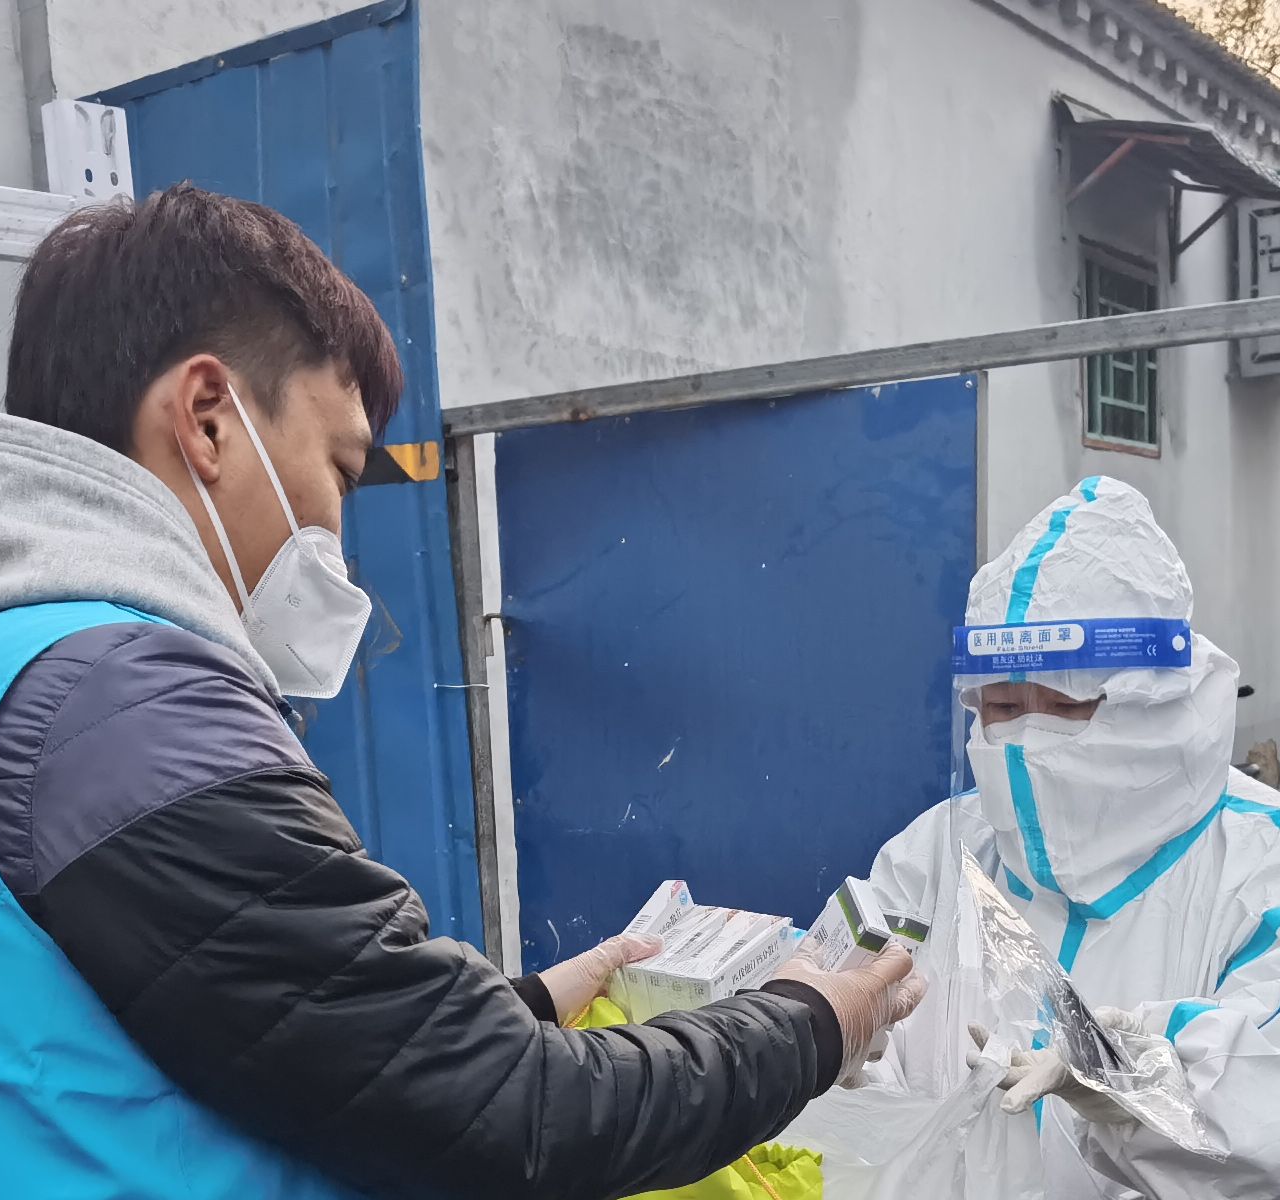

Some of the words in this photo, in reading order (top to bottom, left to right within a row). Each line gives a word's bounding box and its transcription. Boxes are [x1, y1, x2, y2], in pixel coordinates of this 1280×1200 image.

[973, 627, 1072, 647] 医用隔离面罩
